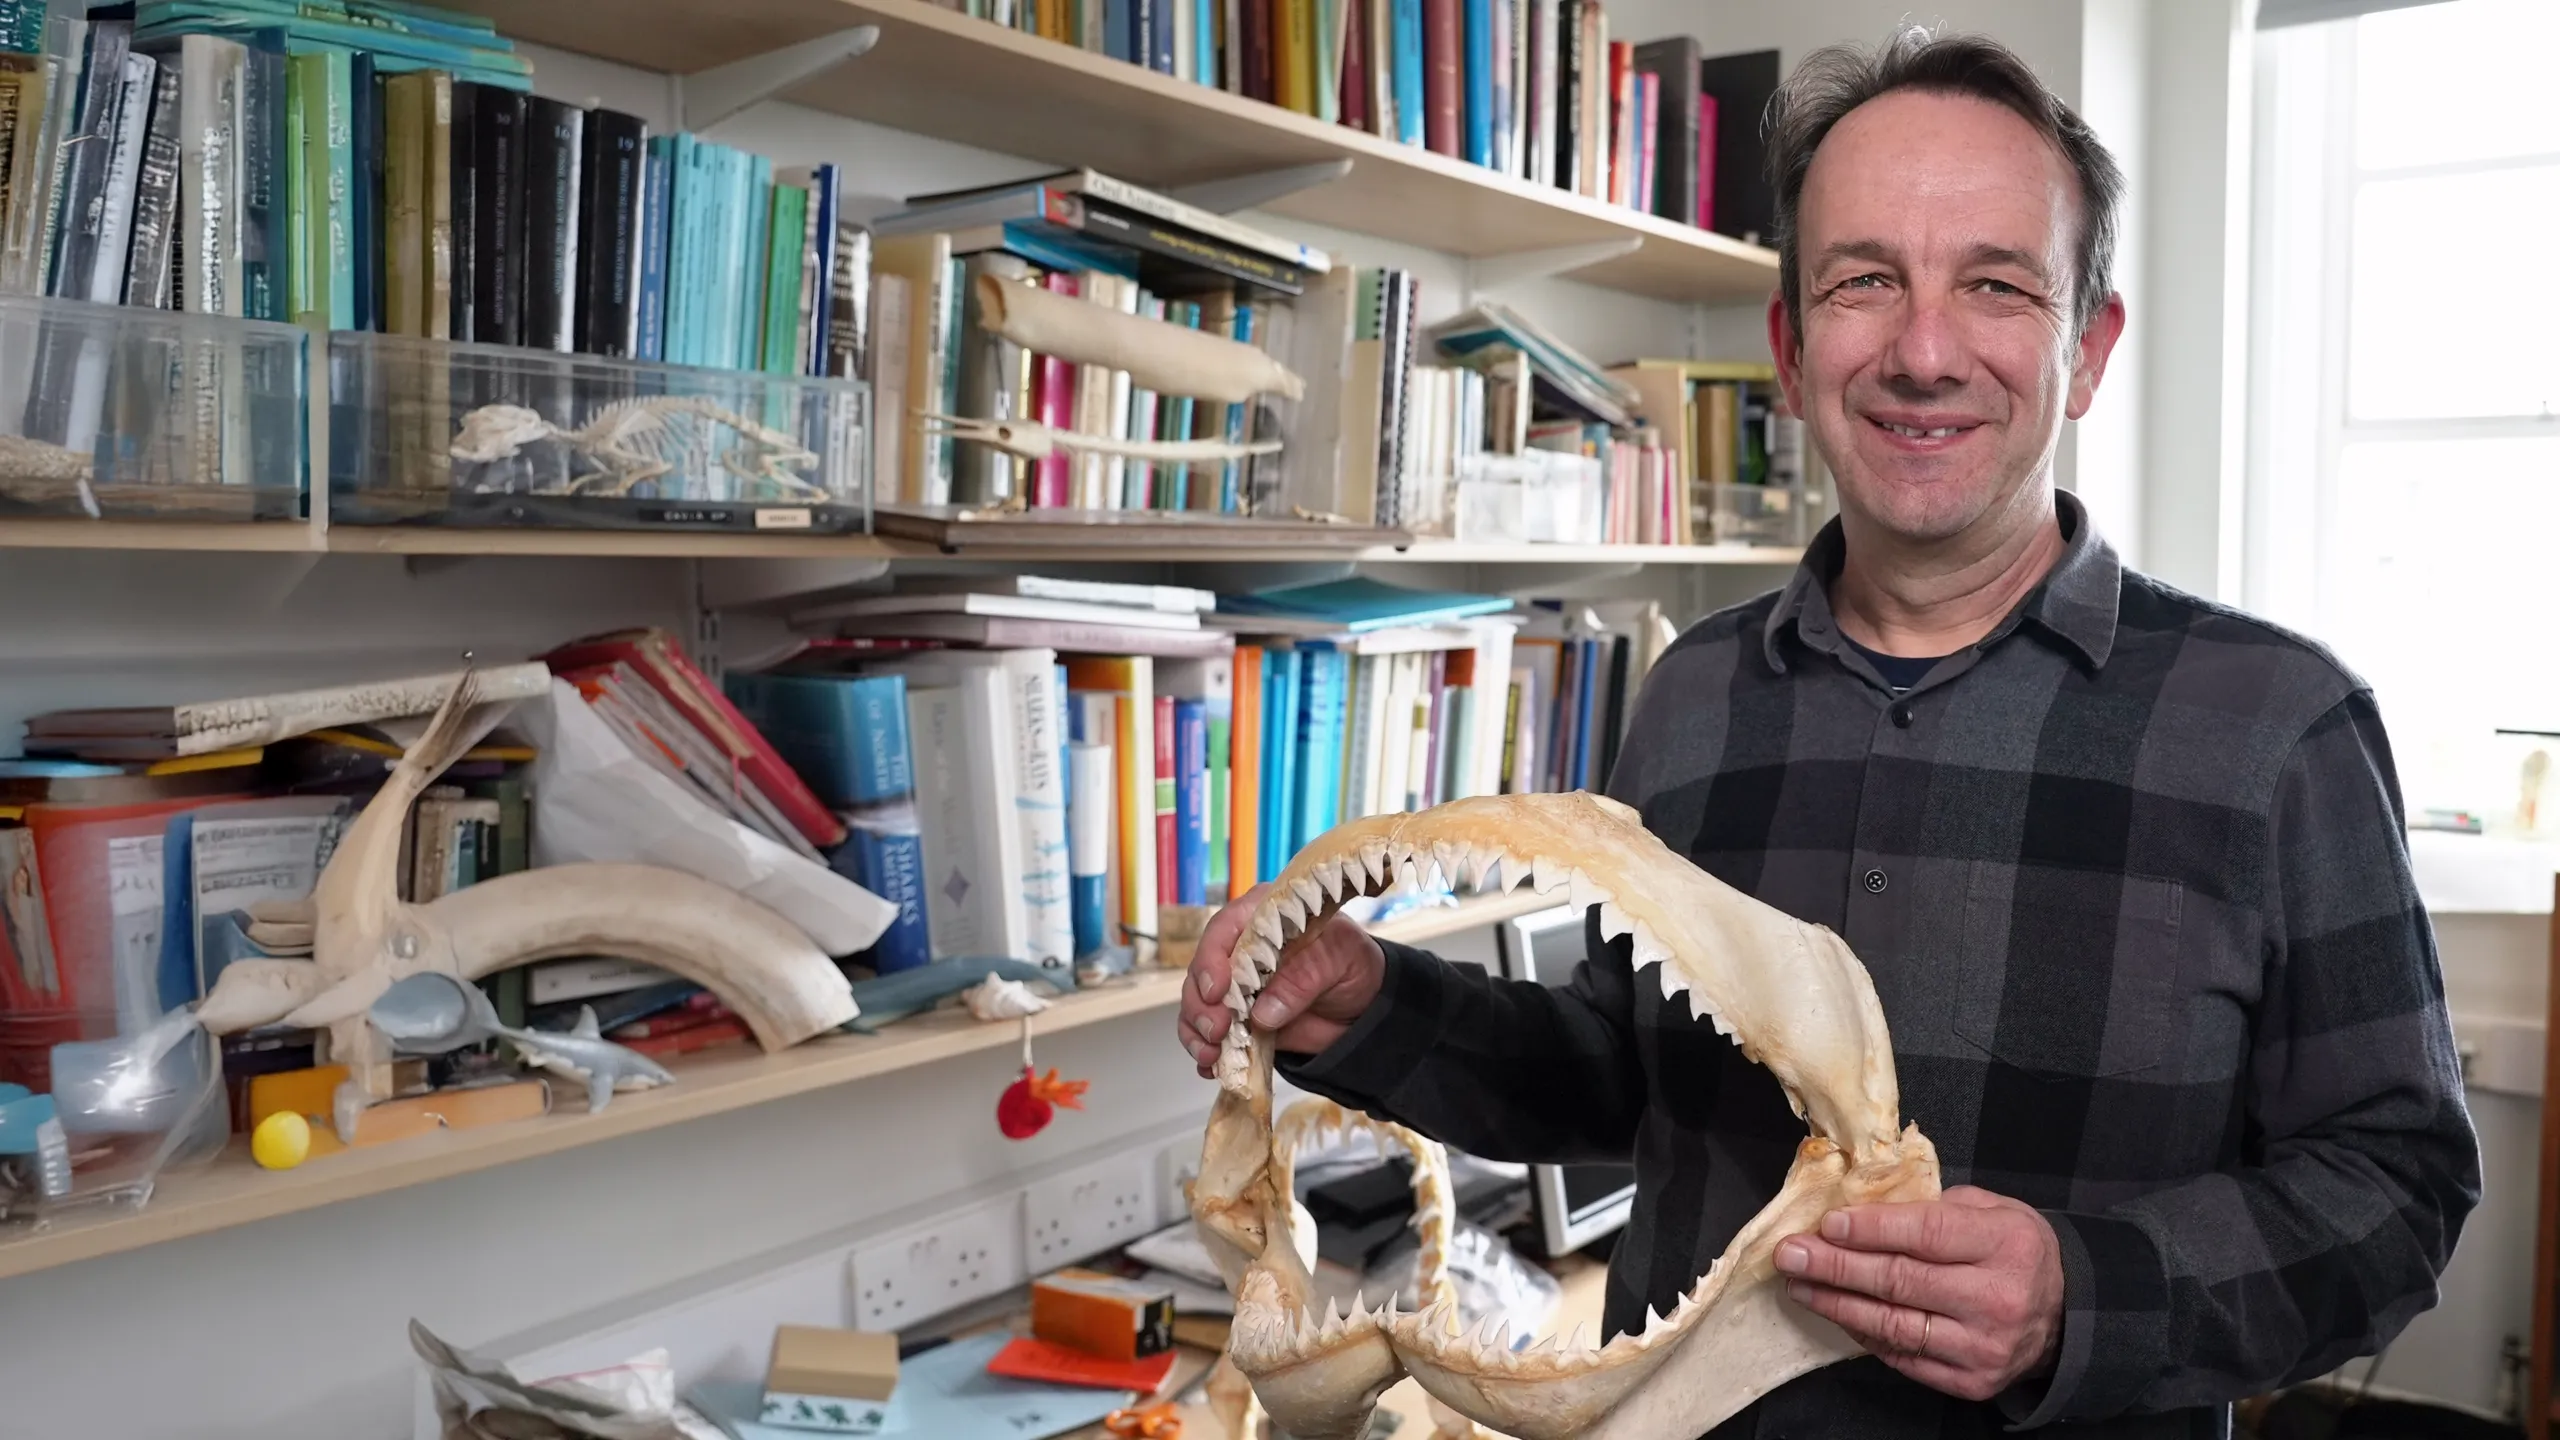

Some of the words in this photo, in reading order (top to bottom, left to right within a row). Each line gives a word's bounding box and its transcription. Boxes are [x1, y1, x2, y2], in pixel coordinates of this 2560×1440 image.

[553, 125, 571, 141] 16
[617, 136, 635, 152] 19
[1024, 673, 1046, 737] SHARKS
[870, 728, 890, 792] NORTH
[890, 753, 907, 786] THE
[1030, 750, 1049, 791] RAYS
[898, 839, 920, 927] SHARKS
